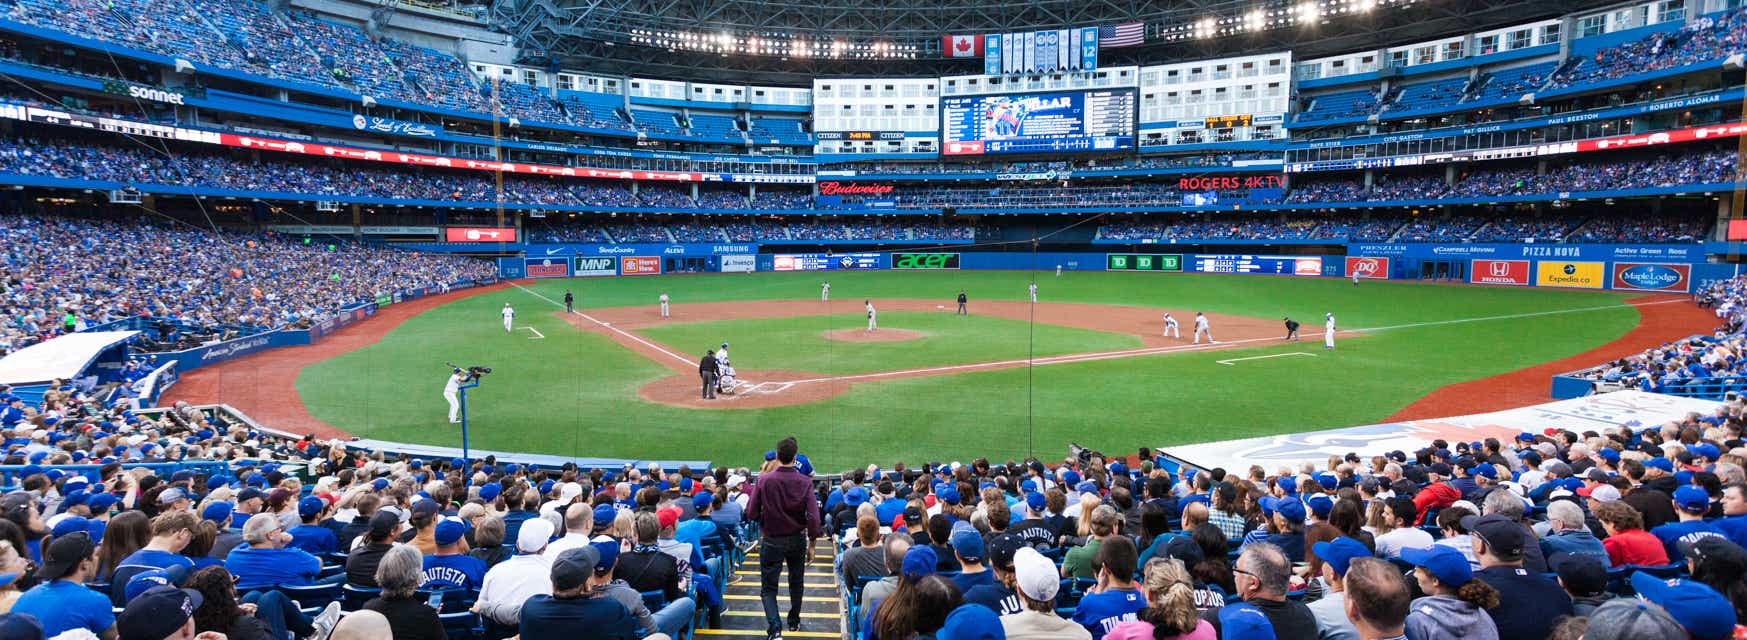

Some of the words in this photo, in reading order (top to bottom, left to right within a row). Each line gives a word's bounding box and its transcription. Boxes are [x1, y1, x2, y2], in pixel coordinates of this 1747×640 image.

[1083, 46, 1095, 57] 12
[129, 85, 184, 105] sonnet
[1649, 101, 1684, 112] ROBERTO
[1686, 95, 1720, 106] ALOMAR
[1548, 117, 1564, 125] PAUL
[818, 181, 894, 195] Budweiser
[1179, 178, 1240, 190] ROGERS
[1523, 246, 1551, 256] PIZZA
[1554, 247, 1580, 257] NOVA
[580, 259, 611, 270] MNP
[897, 253, 954, 268] acer
[1115, 258, 1126, 267] TD
[1140, 258, 1151, 267] TD
[1165, 259, 1177, 268] TD
[1359, 261, 1376, 272] DQ
[1624, 272, 1650, 282] Maple
[1650, 273, 1678, 283] Lodge
[419, 566, 466, 588] AUTISTA
